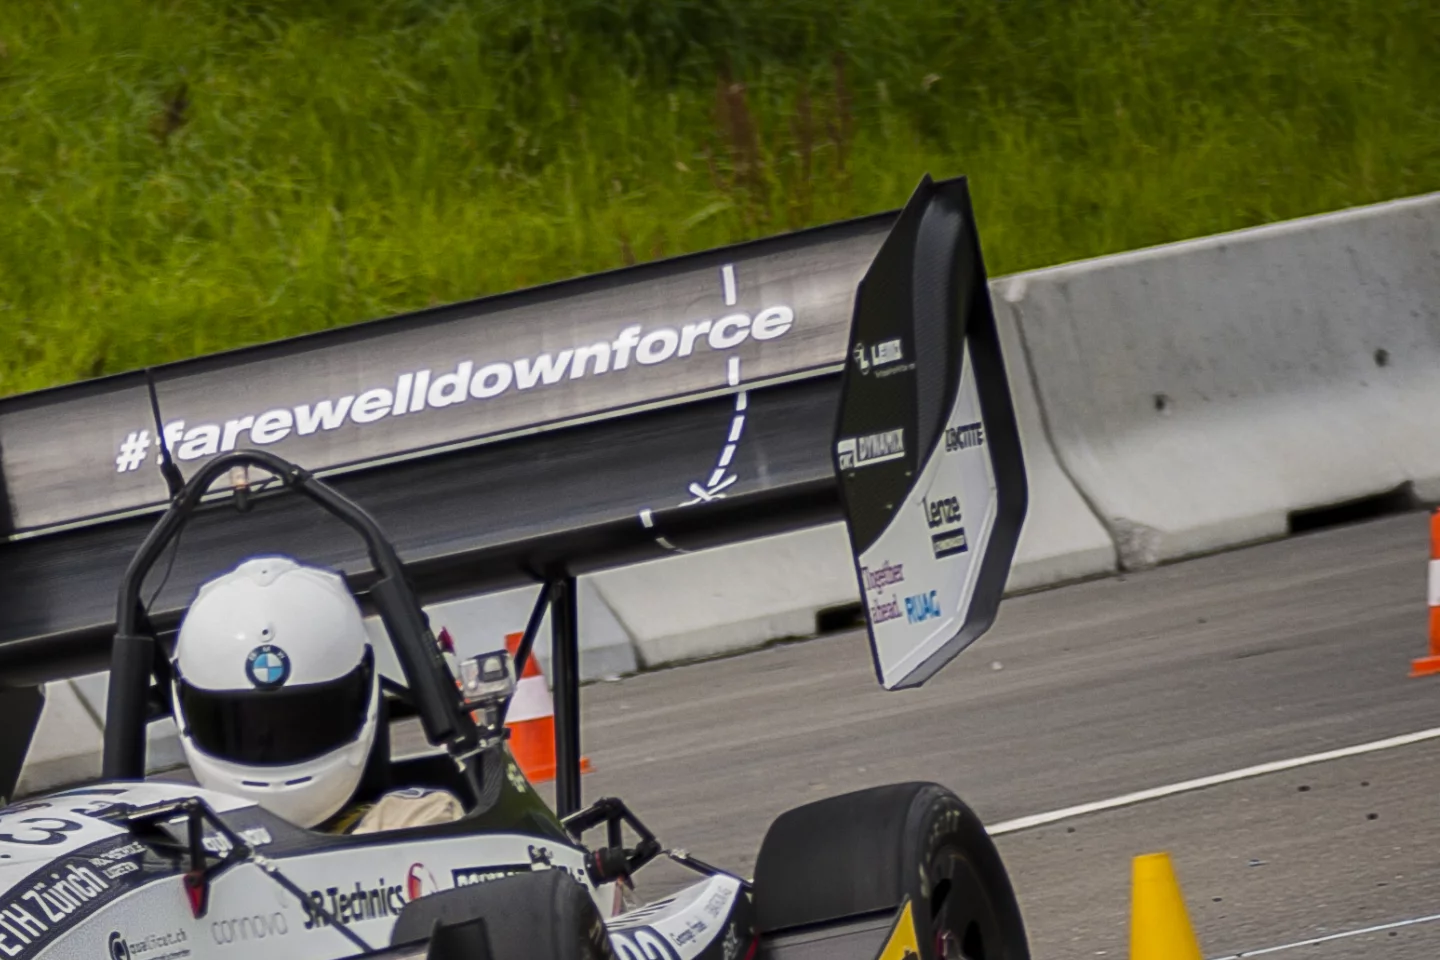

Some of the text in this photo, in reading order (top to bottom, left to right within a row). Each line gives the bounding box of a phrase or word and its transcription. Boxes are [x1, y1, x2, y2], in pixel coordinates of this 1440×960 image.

[115, 305, 795, 473] #farewelldownforce
[922, 496, 962, 529] Lenze
[904, 590, 941, 624] RUAG
[21, 864, 109, 923] Zürich
[325, 877, 408, 926] Technics
